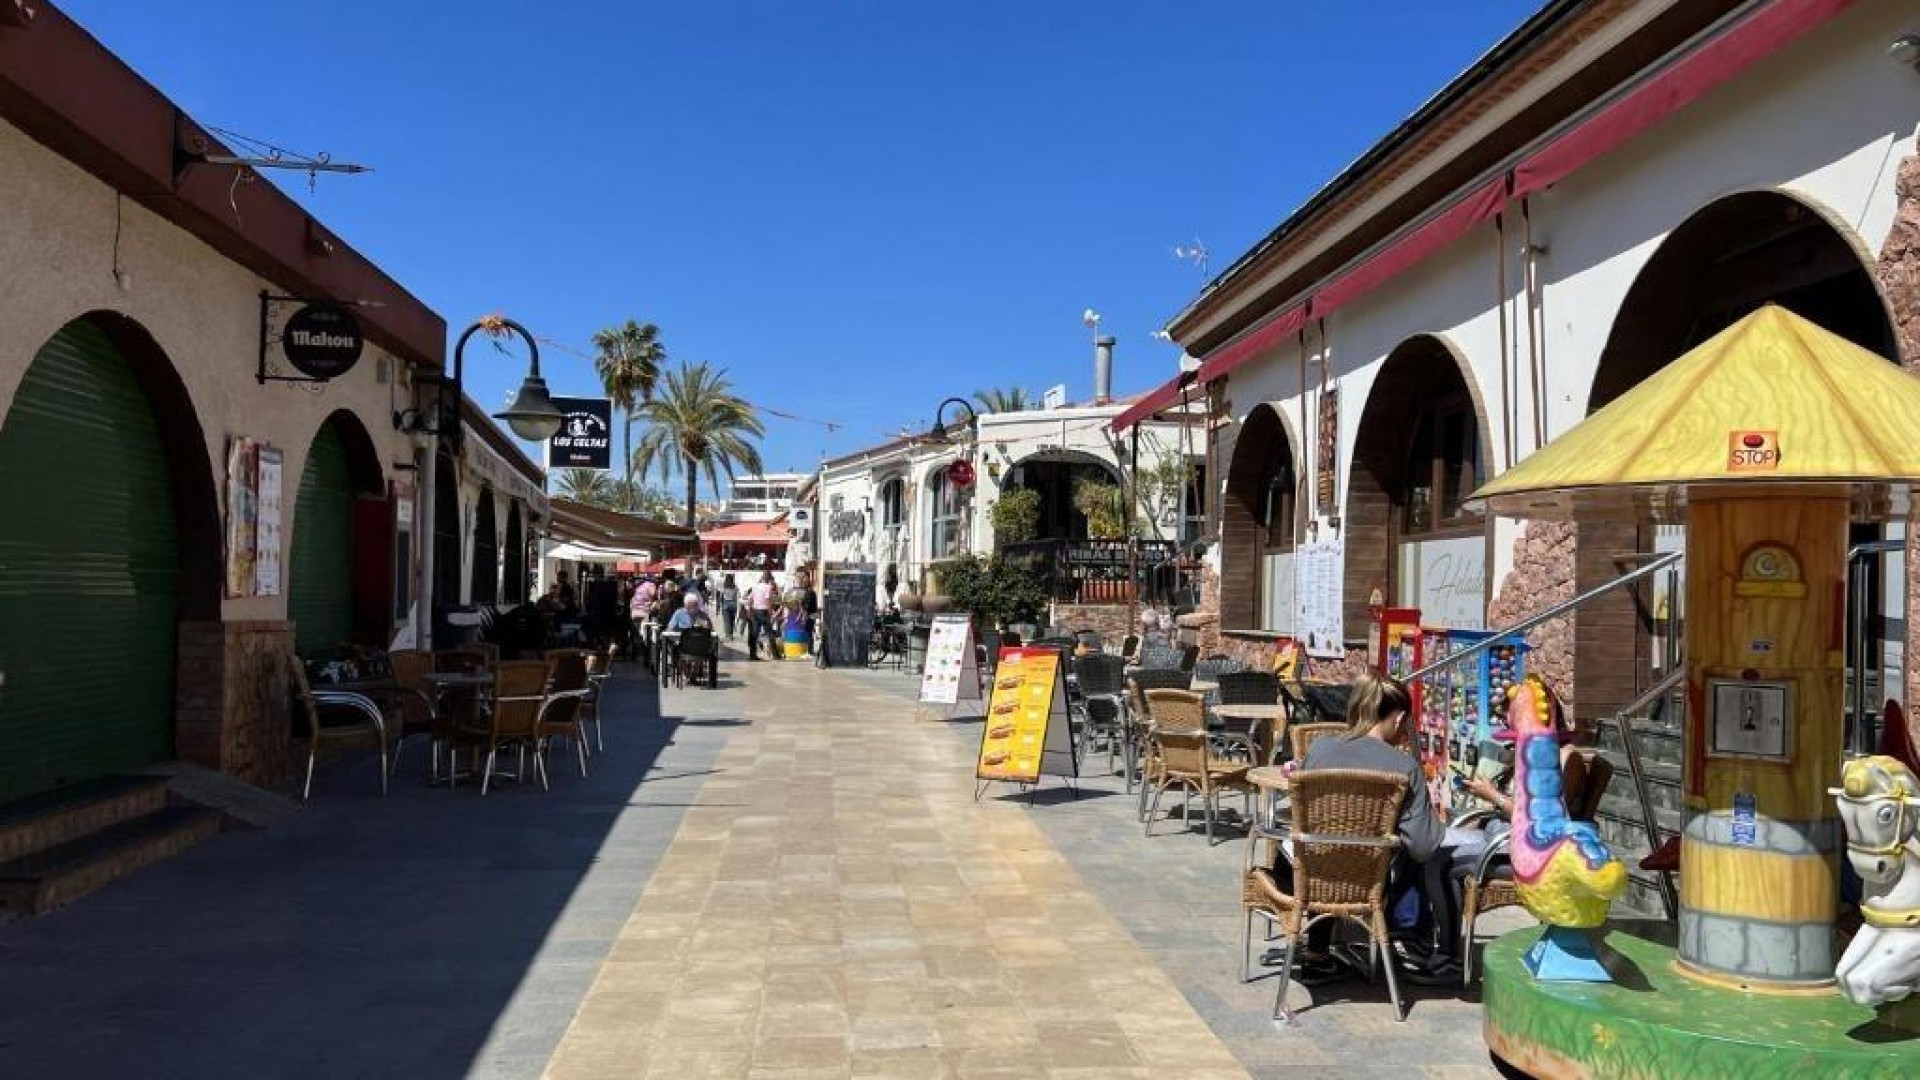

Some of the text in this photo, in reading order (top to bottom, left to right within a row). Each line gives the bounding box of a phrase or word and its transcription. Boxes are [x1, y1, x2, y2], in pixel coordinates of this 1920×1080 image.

[291, 330, 354, 348] Mahou
[554, 436, 571, 447] LOS
[1732, 449, 1775, 466] STOP
